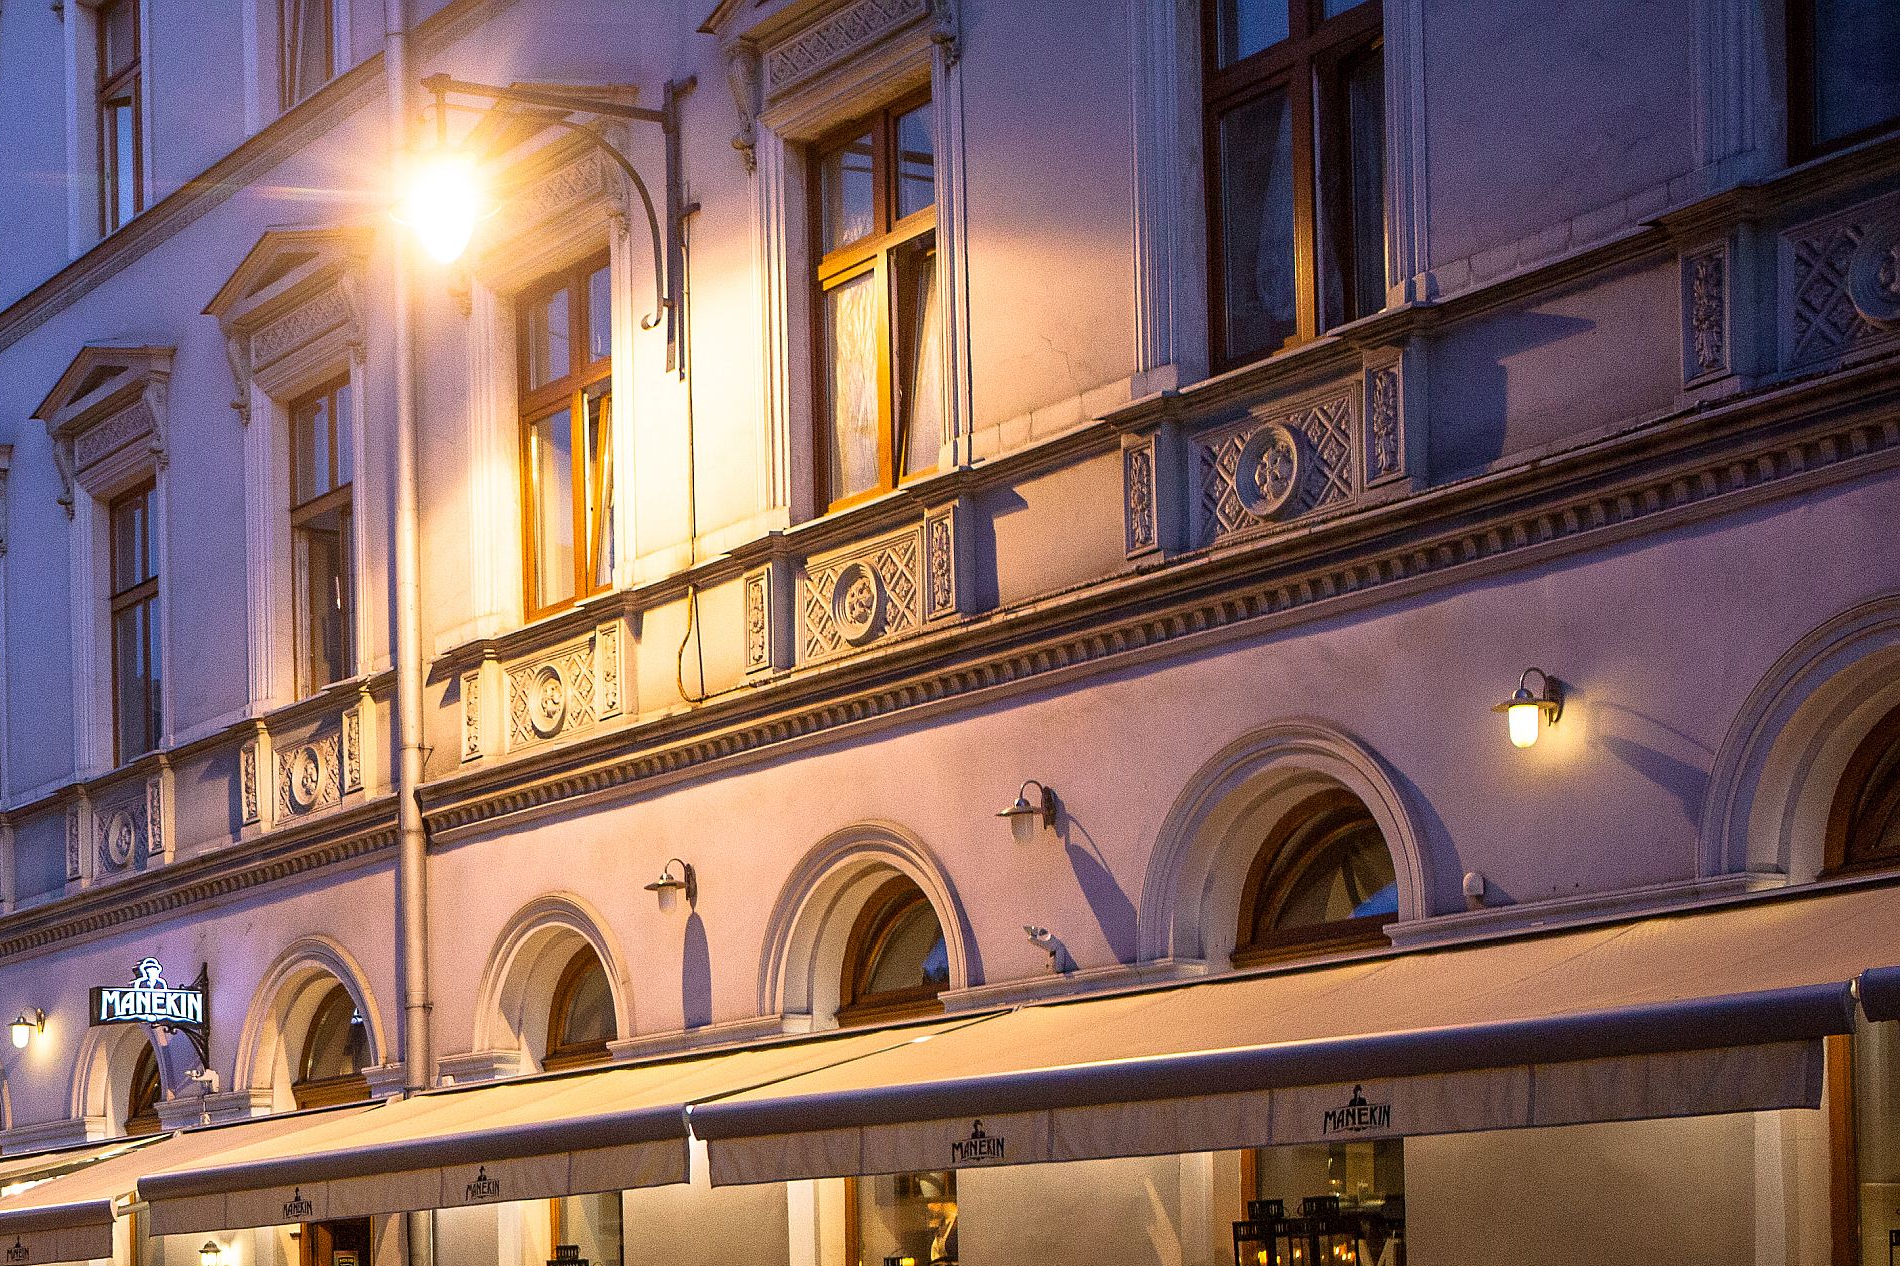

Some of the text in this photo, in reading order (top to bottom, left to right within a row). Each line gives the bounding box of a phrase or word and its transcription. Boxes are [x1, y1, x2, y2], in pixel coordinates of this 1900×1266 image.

[100, 991, 203, 1023] MANEKIN
[1323, 1105, 1391, 1134] MANEKIN
[951, 1138, 1005, 1163] MANEKIN
[465, 1180, 500, 1201] MANEKIN
[283, 1201, 313, 1219] MANEKIN
